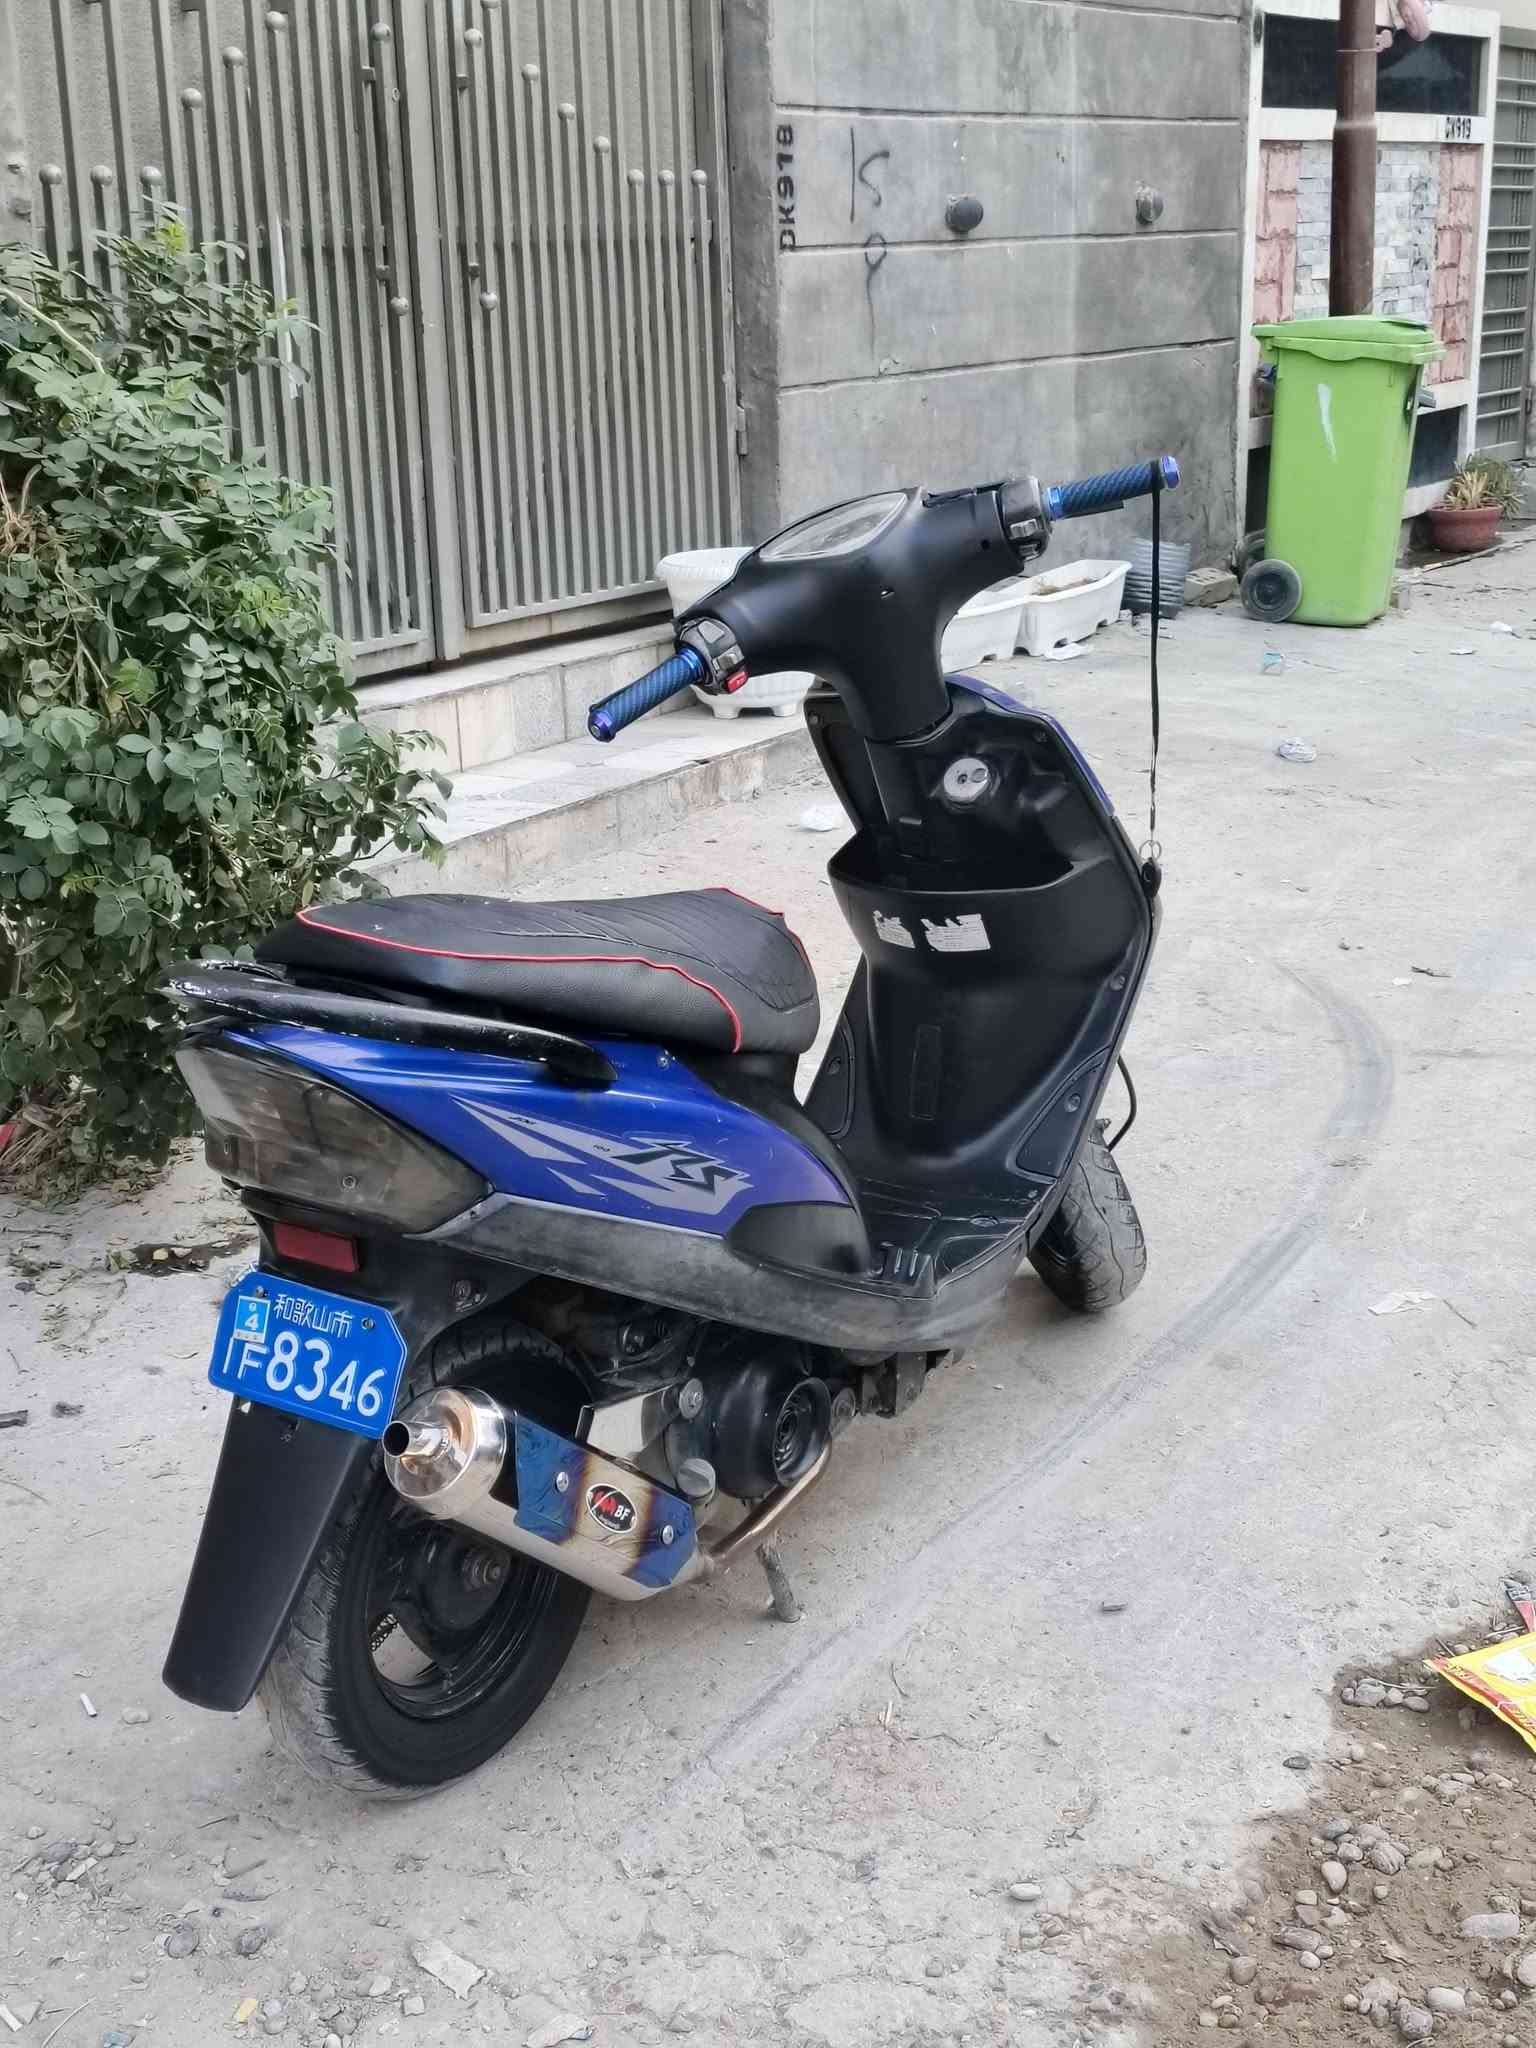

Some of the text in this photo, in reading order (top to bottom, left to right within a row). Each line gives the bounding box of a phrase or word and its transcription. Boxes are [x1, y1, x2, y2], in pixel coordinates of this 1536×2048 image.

[776, 124, 796, 251] DK918
[273, 1293, 354, 1339] 和歌山市
